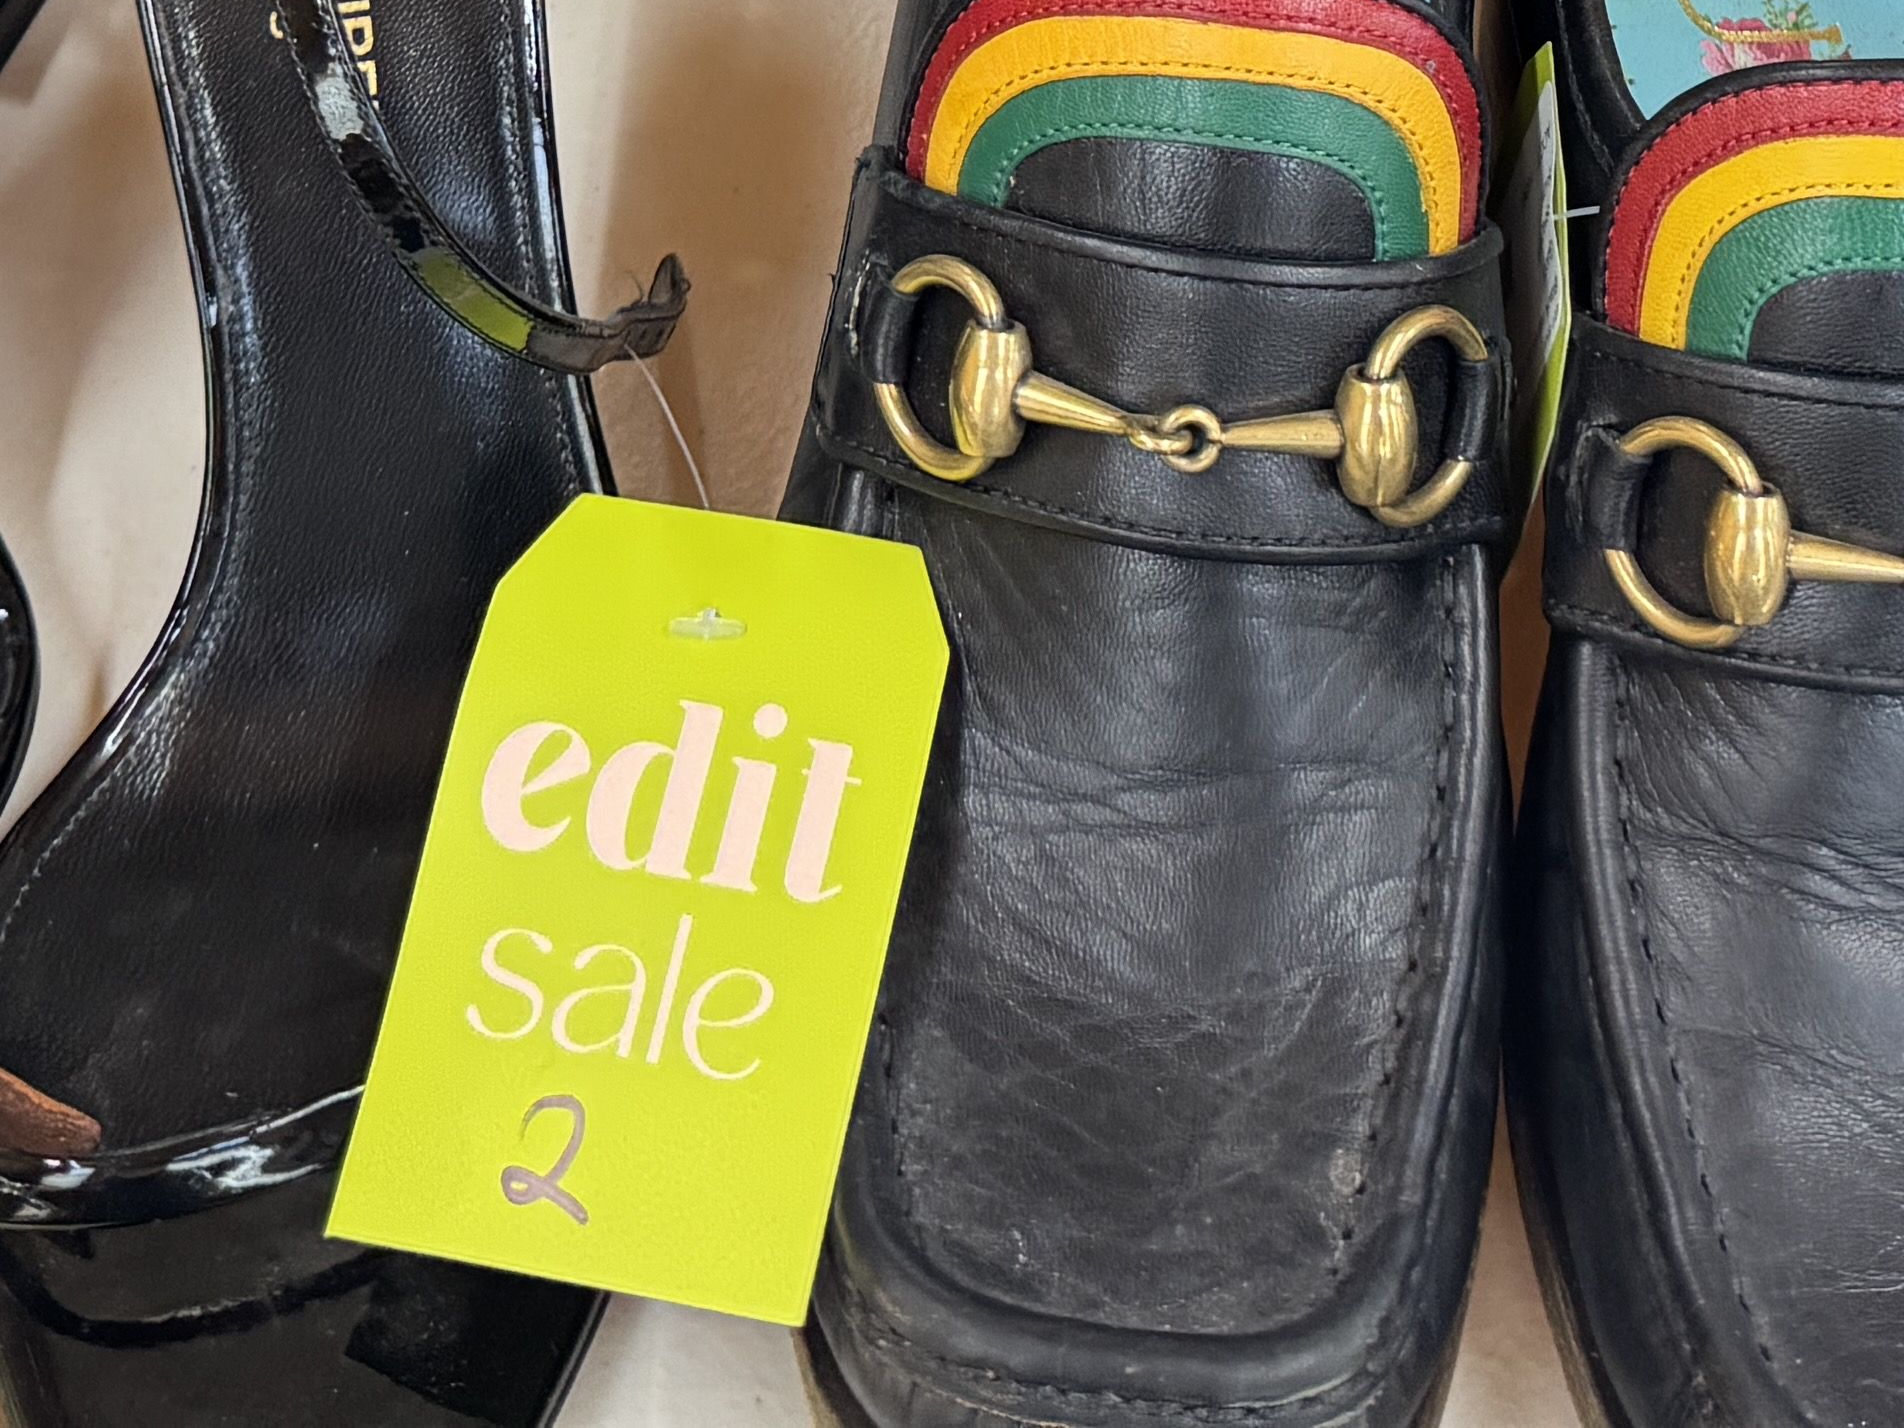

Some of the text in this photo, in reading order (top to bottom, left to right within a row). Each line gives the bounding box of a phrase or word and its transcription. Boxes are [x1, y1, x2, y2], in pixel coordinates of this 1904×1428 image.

[480, 697, 863, 904] edit
[465, 912, 776, 1082] sale
[499, 1093, 589, 1227] 2
